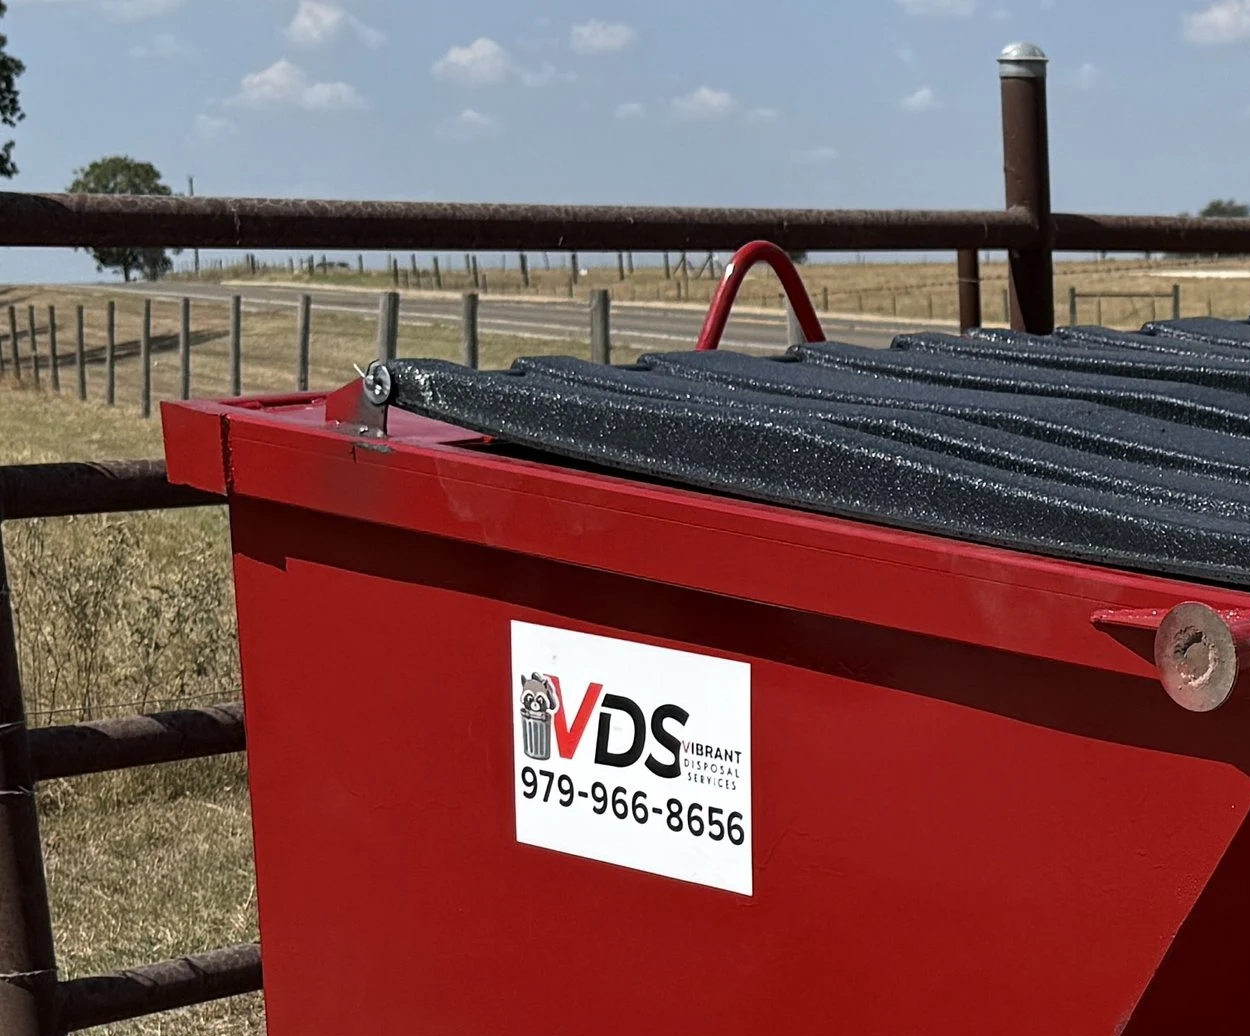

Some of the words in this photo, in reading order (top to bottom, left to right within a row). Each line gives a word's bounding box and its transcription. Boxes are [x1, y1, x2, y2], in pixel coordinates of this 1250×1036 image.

[542, 673, 690, 779] VDS
[682, 740, 742, 765] VIBRANT
[684, 758, 740, 779] DISPOSAL
[687, 772, 737, 791] SERVICES
[521, 766, 745, 846] 979-966-8656
